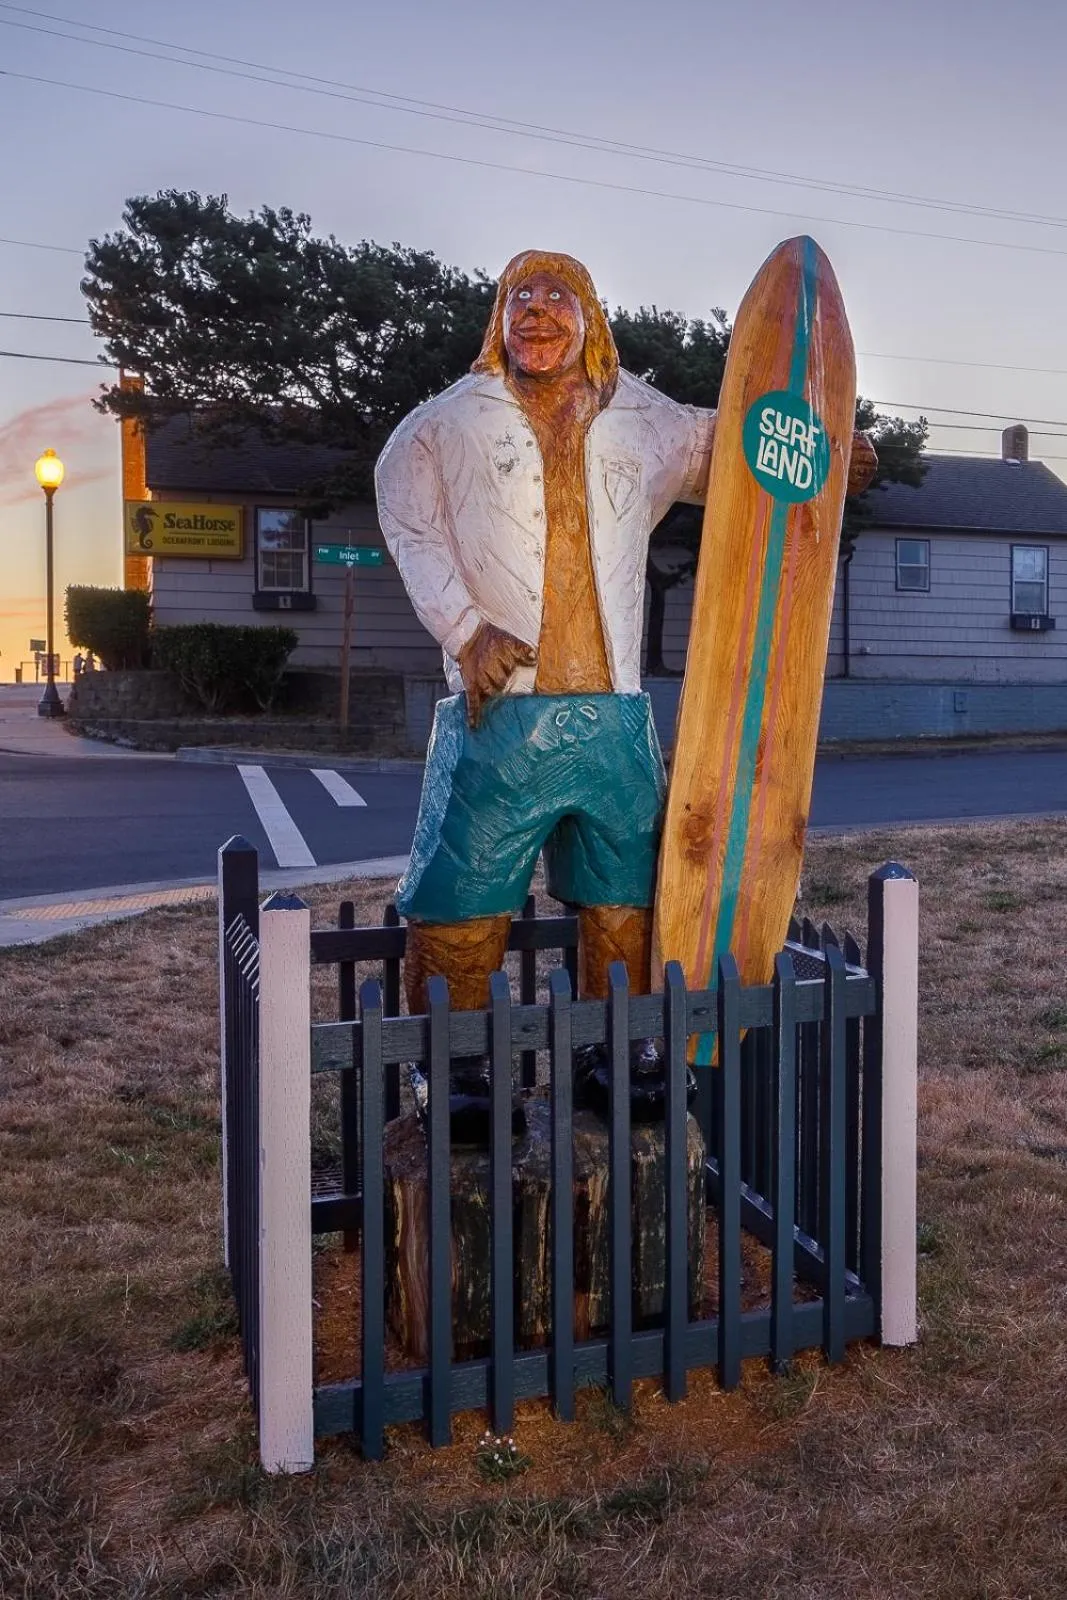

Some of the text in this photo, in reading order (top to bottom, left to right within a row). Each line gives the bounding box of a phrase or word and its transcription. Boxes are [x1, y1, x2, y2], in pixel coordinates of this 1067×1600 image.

[759, 407, 820, 457] SURF
[756, 436, 813, 490] LAND
[163, 512, 236, 531] SeaHorse
[339, 551, 359, 560] Inlet
